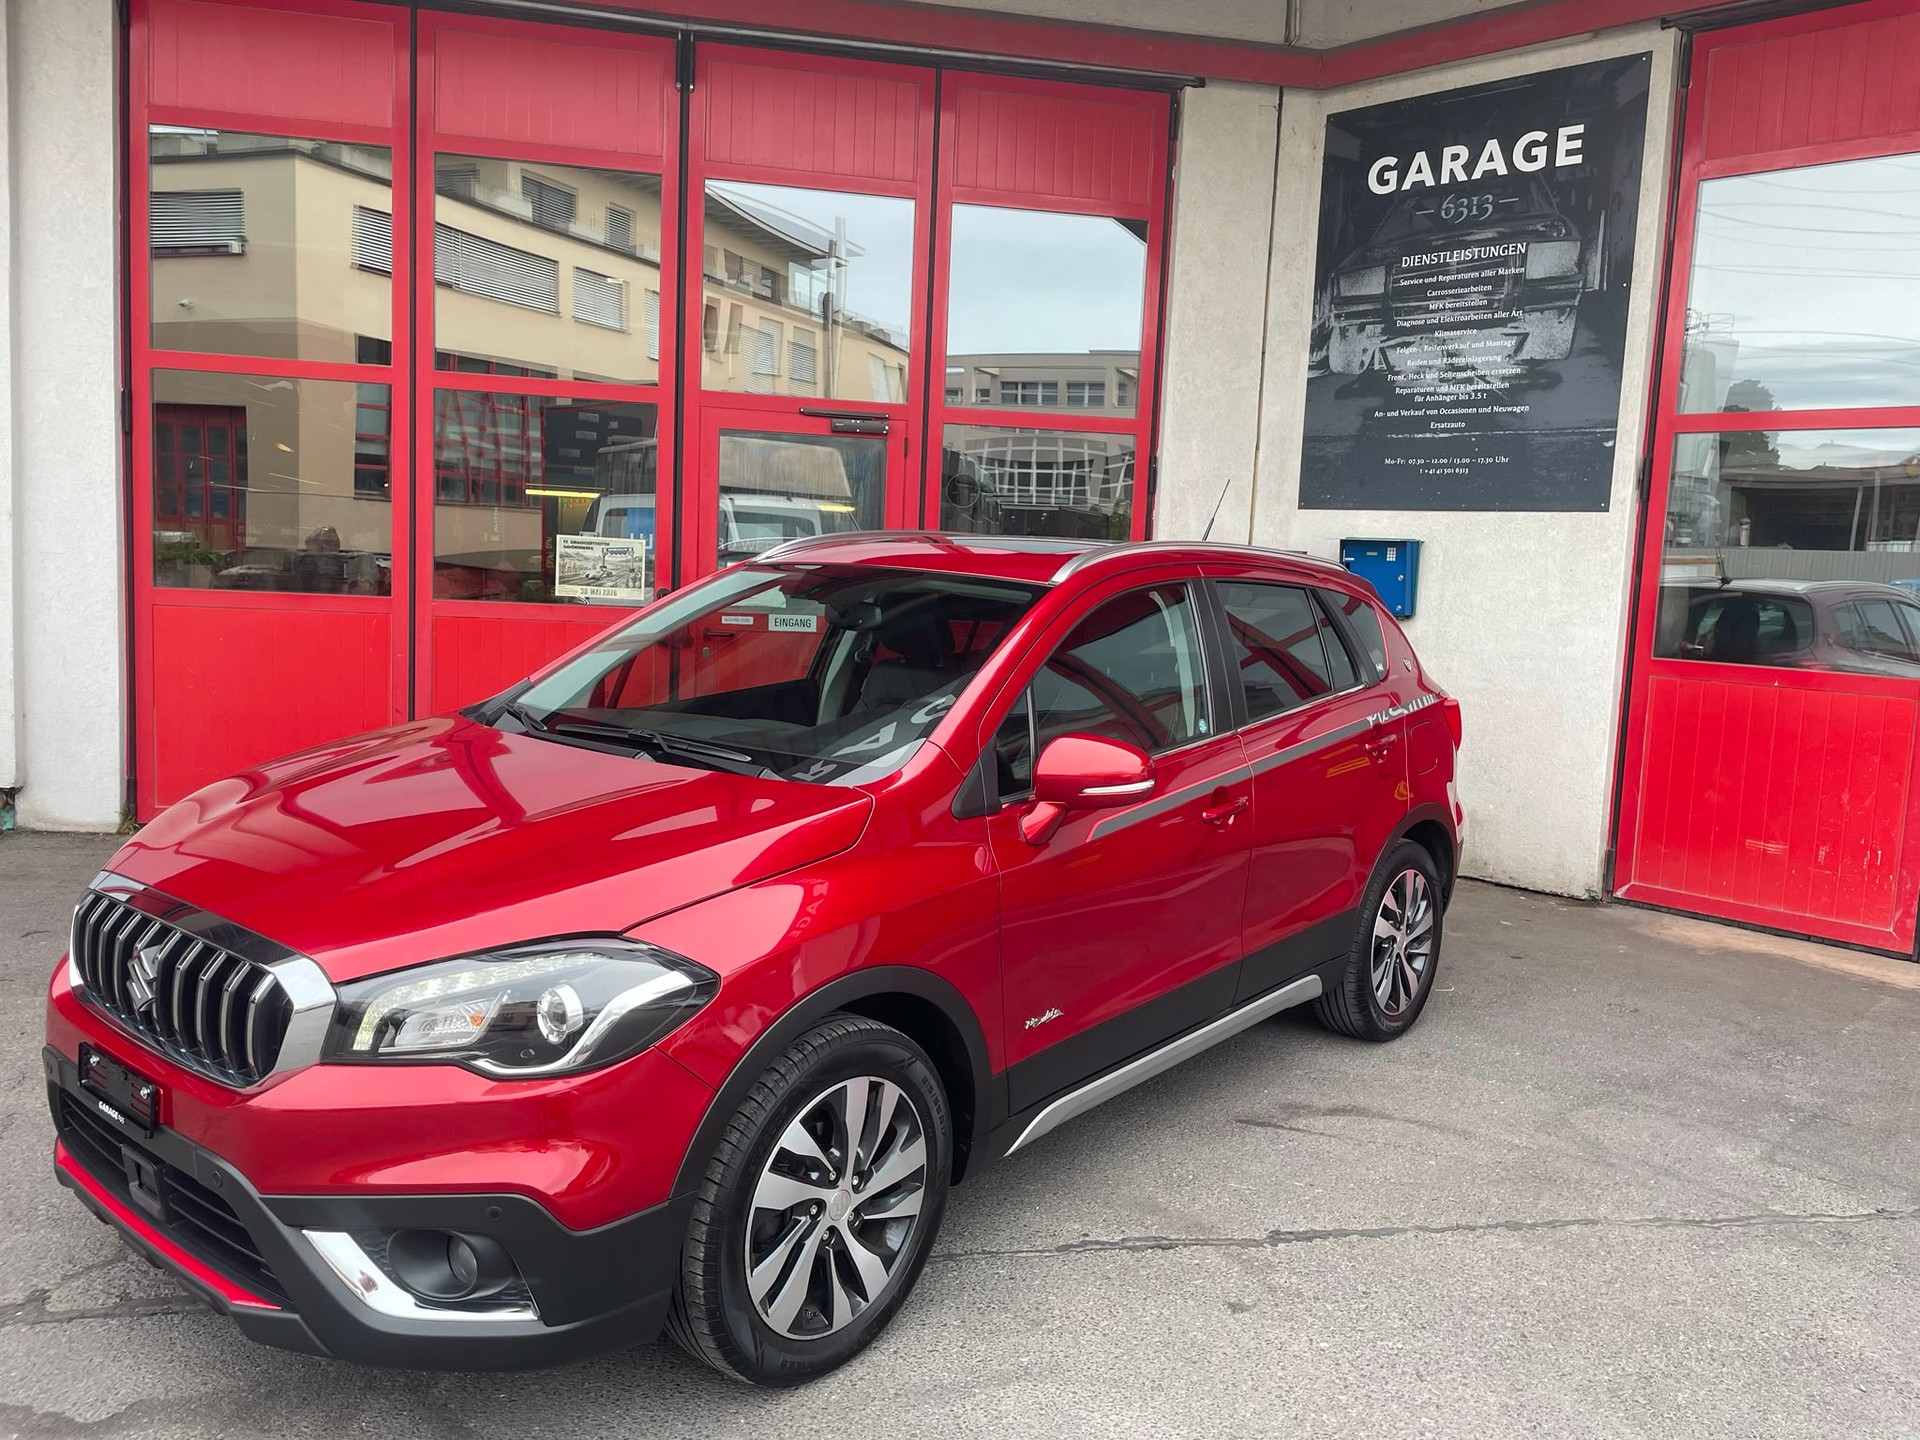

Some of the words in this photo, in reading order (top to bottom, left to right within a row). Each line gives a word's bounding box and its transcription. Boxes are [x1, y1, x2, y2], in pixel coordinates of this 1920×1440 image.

[1367, 124, 1585, 195] GARAGE
[1441, 193, 1494, 224] 6313
[1402, 242, 1527, 268] DIENSTLEISTUNGEN
[1400, 278, 1423, 286] Service
[1438, 272, 1480, 282] Reparaturen
[1498, 267, 1525, 276] Marken
[1427, 284, 1492, 297] Carrosseriearbeiten
[1428, 302, 1444, 310] MFK
[1445, 300, 1488, 308] bereitstellen
[1396, 319, 1425, 328] Diagnose
[1440, 312, 1492, 324] Elektroarbeiten
[1494, 310, 1510, 318] aller
[1511, 309, 1523, 317] Art
[1434, 328, 1478, 337] Klimaservice
[1424, 342, 1470, 352] Reifenverkauf
[1486, 339, 1516, 348] Montage
[1443, 355, 1502, 364] Rädereinlagerung
[1440, 368, 1490, 378] Seitenscheiben
[1491, 368, 1521, 376] ersetzen
[1395, 386, 1434, 395] Reparaturen
[1466, 382, 1510, 390] bereitstellen
[1425, 394, 1457, 402] Anhänger
[1400, 408, 1424, 417] Verkauf
[1440, 407, 1477, 415] Occasionen
[1493, 405, 1530, 414] Neuwagen
[774, 618, 811, 628] EINGANG
[98, 1100, 118, 1120] GARAGE
